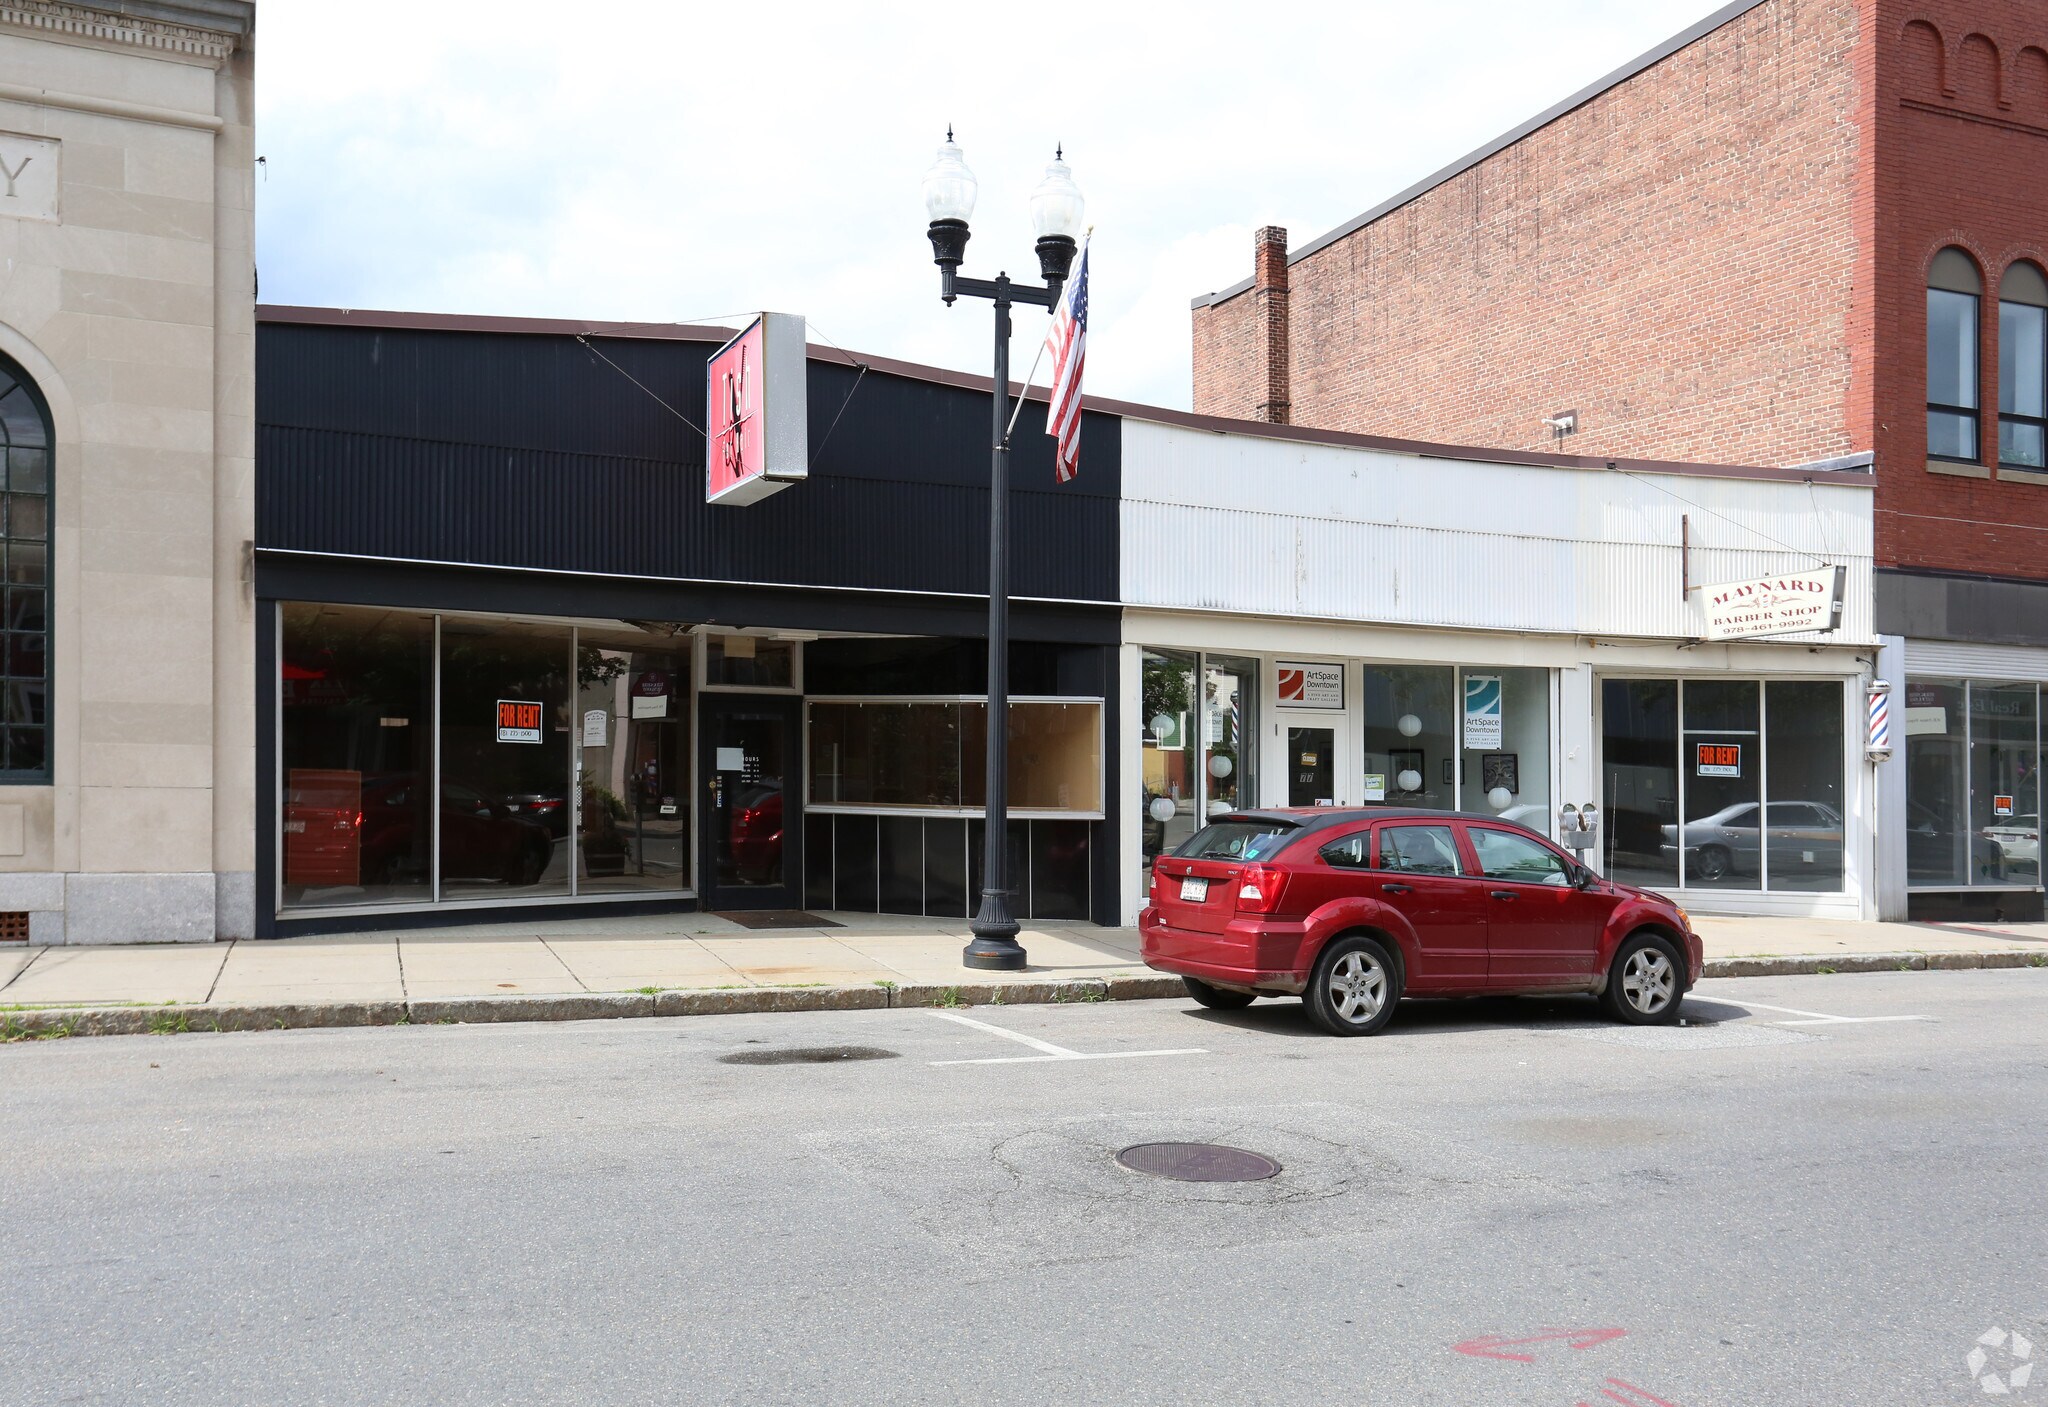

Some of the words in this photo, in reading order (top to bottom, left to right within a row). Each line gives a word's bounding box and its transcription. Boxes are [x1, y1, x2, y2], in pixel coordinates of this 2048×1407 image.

[1712, 580, 1824, 608] MAYNARD
[1713, 612, 1773, 626] BARBER
[1780, 605, 1822, 617] SHOP
[1723, 618, 1812, 635] 978-461-9992
[1306, 671, 1339, 681] ArtSpace
[1306, 681, 1339, 689] Downtown
[499, 704, 515, 727] FOR
[517, 705, 540, 728] RENT
[1466, 718, 1500, 727] ArtSpace
[1466, 726, 1500, 734] Downtown
[1700, 746, 1714, 764] FOR
[1716, 747, 1738, 765] RENT
